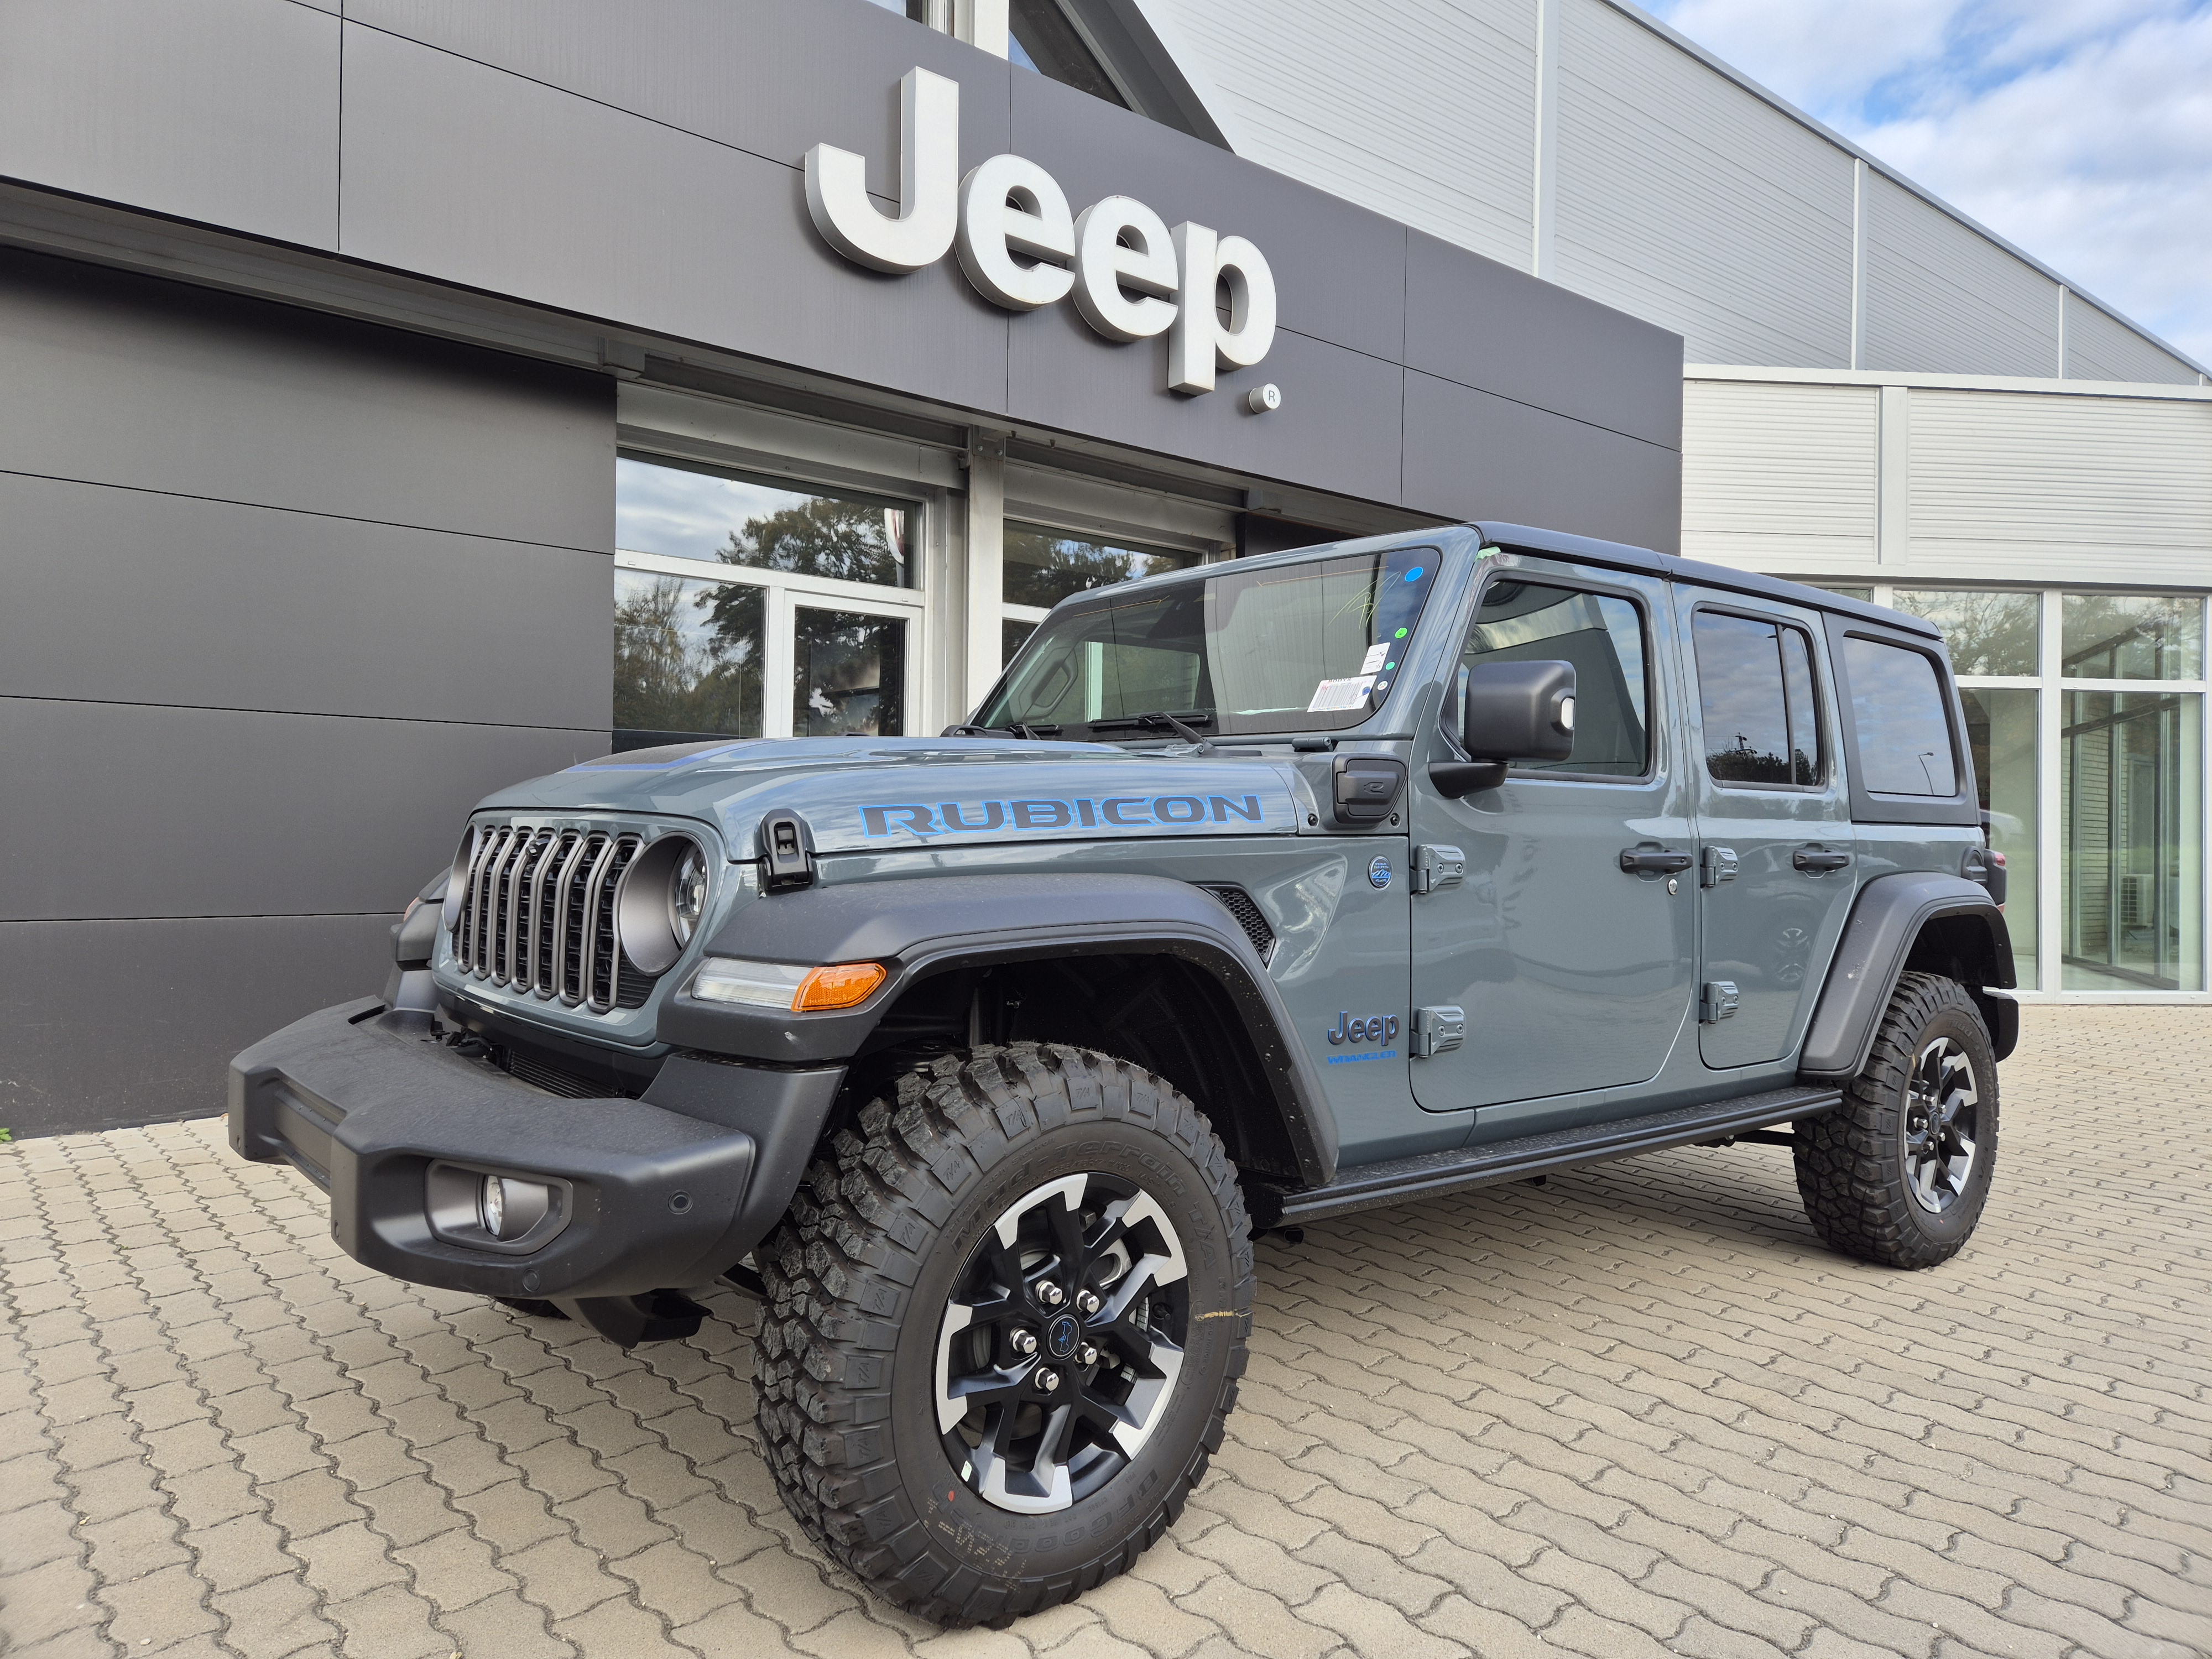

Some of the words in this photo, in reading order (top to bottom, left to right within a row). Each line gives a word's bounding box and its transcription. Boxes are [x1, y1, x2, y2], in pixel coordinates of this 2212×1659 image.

[805, 66, 1277, 397] Jeep
[858, 795, 1265, 838] RUBICON
[1327, 1050, 1397, 1066] WRANGLER
[1328, 1011, 1400, 1046] Jeep
[950, 1140, 1187, 1255] Mud-Terrain
[1188, 1201, 1217, 1270] T/A
[931, 1468, 1160, 1553] BFGoodrich
